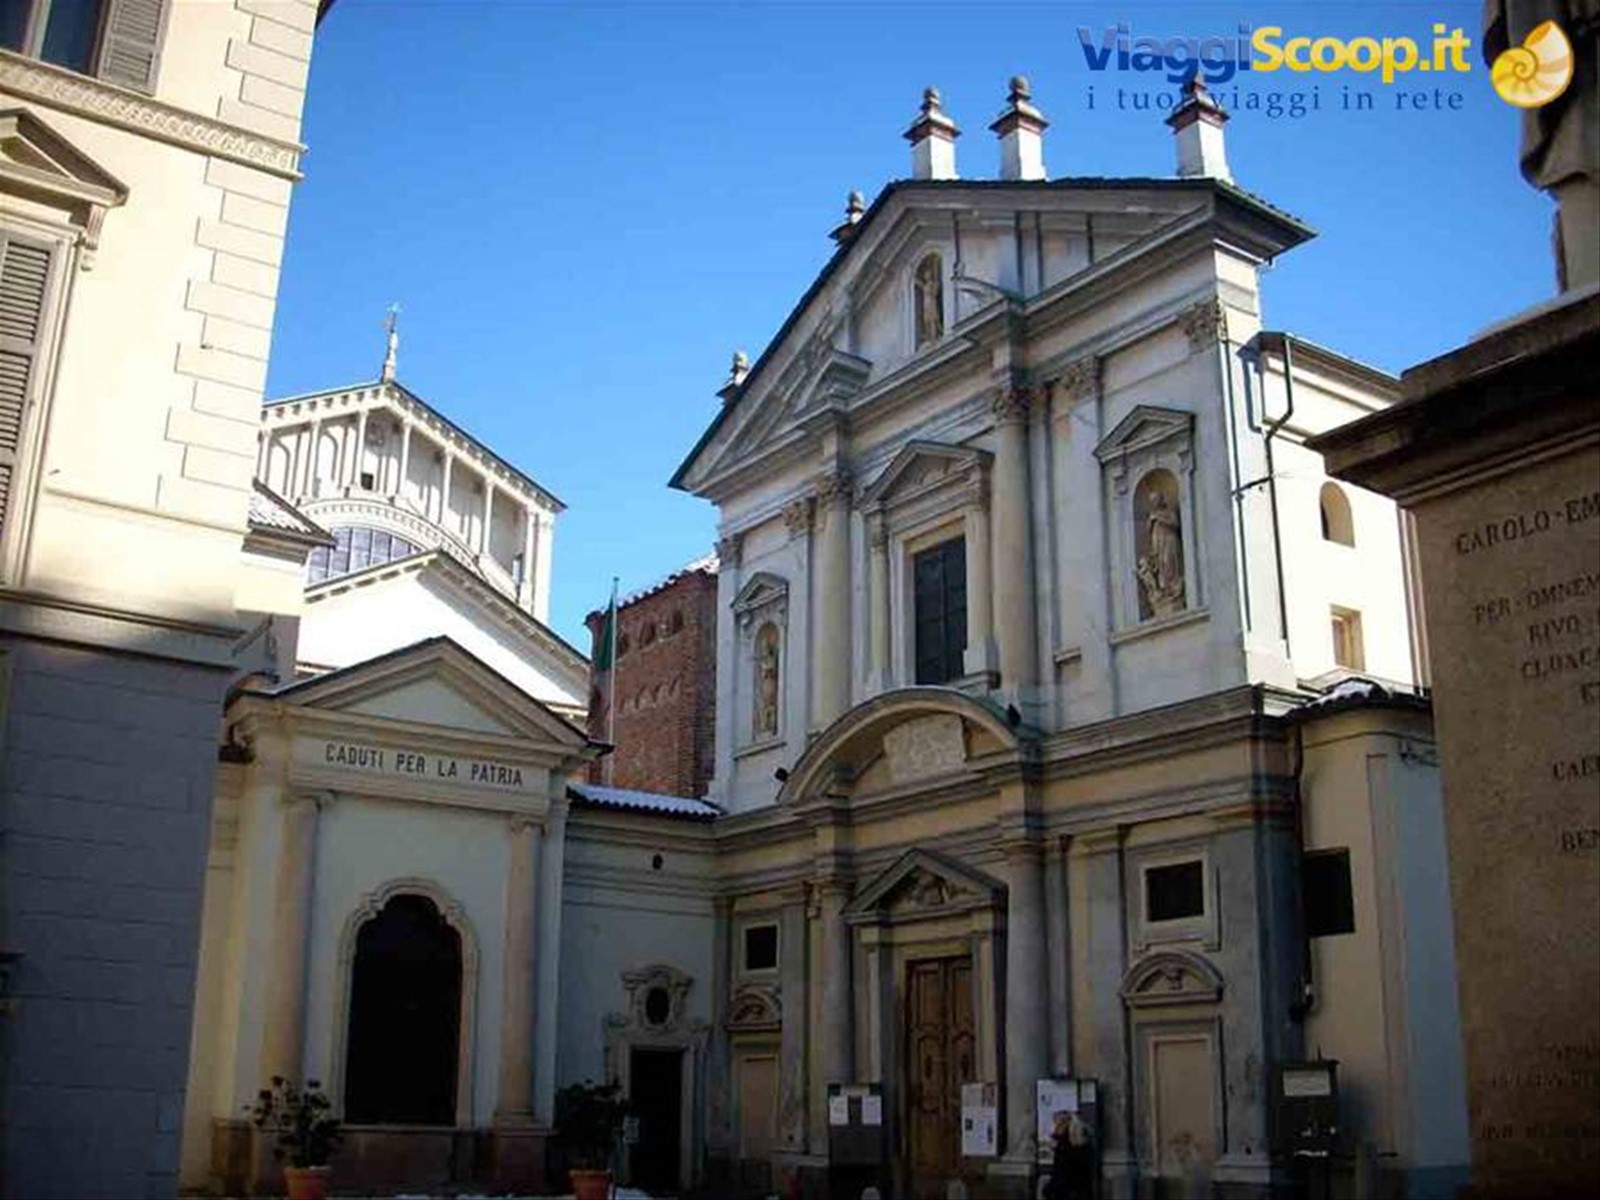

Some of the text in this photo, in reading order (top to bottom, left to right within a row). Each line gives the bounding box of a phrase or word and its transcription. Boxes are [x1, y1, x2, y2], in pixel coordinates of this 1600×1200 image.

[326, 743, 524, 786] CADUTI PER LA PATRIA
